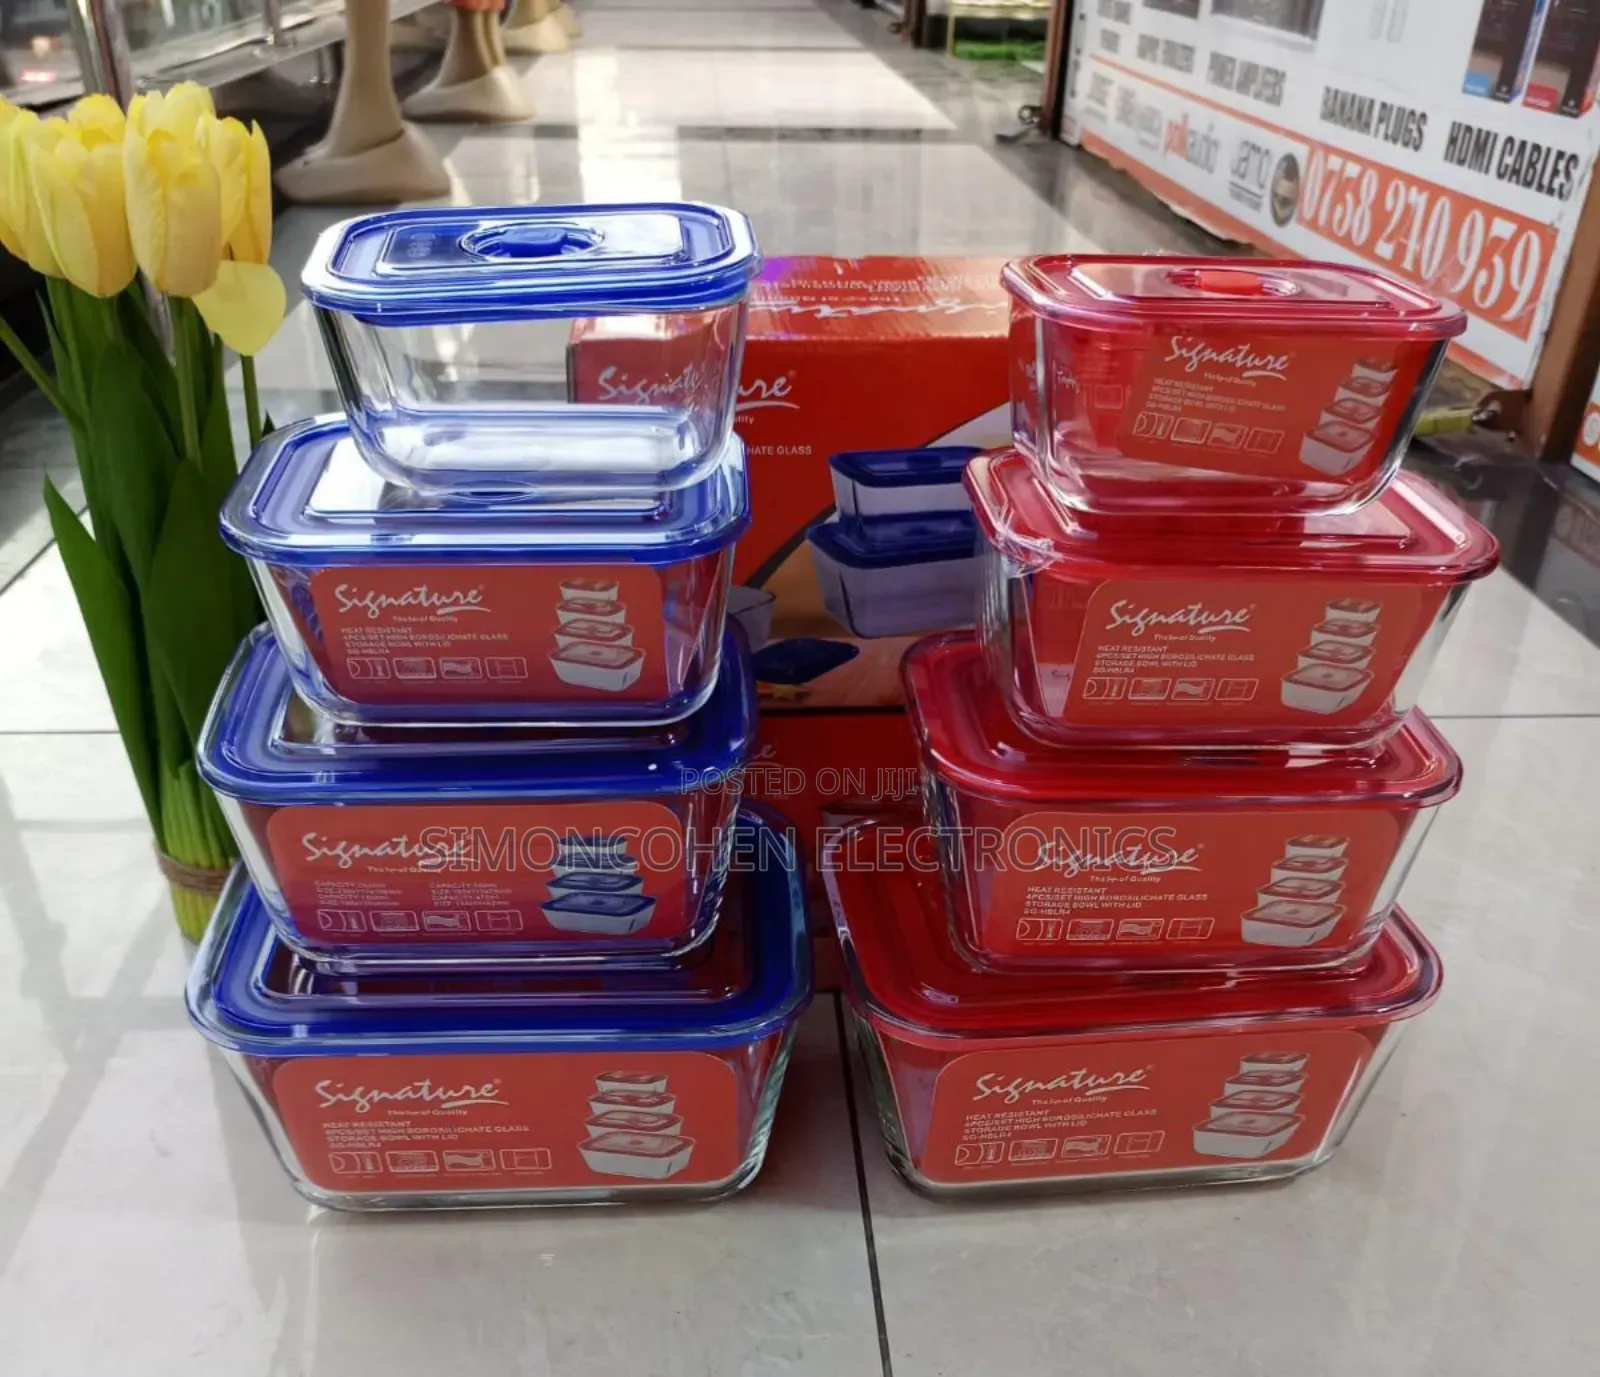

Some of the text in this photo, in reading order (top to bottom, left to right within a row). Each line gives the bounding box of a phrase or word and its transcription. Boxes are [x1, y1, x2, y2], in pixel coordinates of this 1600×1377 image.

[1320, 85, 1428, 153] BANANA PLUGS
[1444, 121, 1580, 203] HDMI CABLES
[1303, 149, 1542, 322] 0738 240 939
[1164, 335, 1290, 381] Signature
[776, 445, 812, 456] GLASS
[335, 584, 491, 619] Signature
[1105, 600, 1251, 637] Signature
[1121, 645, 1168, 653] RESISTANT
[302, 832, 480, 869] Signature
[1034, 841, 1203, 879] Signature
[1129, 875, 1162, 884] Quality
[1027, 886, 1053, 894] HEAT
[1074, 894, 1098, 902] HIGH
[1175, 894, 1209, 902] GLASS
[1025, 901, 1071, 909] STORAGE
[1126, 902, 1142, 910] LID
[973, 1067, 1151, 1104] Signature
[315, 1078, 510, 1113] Signature
[1074, 1095, 1108, 1104] Quality
[432, 1109, 468, 1118] Quality
[965, 1110, 1050, 1121] HEAT RESISTANT
[1015, 1116, 1041, 1125] HIGH
[1123, 1108, 1157, 1118] GLASS
[494, 1125, 530, 1133] GLASS
[963, 1119, 1088, 1135] STORAGE BOWL WITH LID
[441, 1133, 459, 1141] LID
